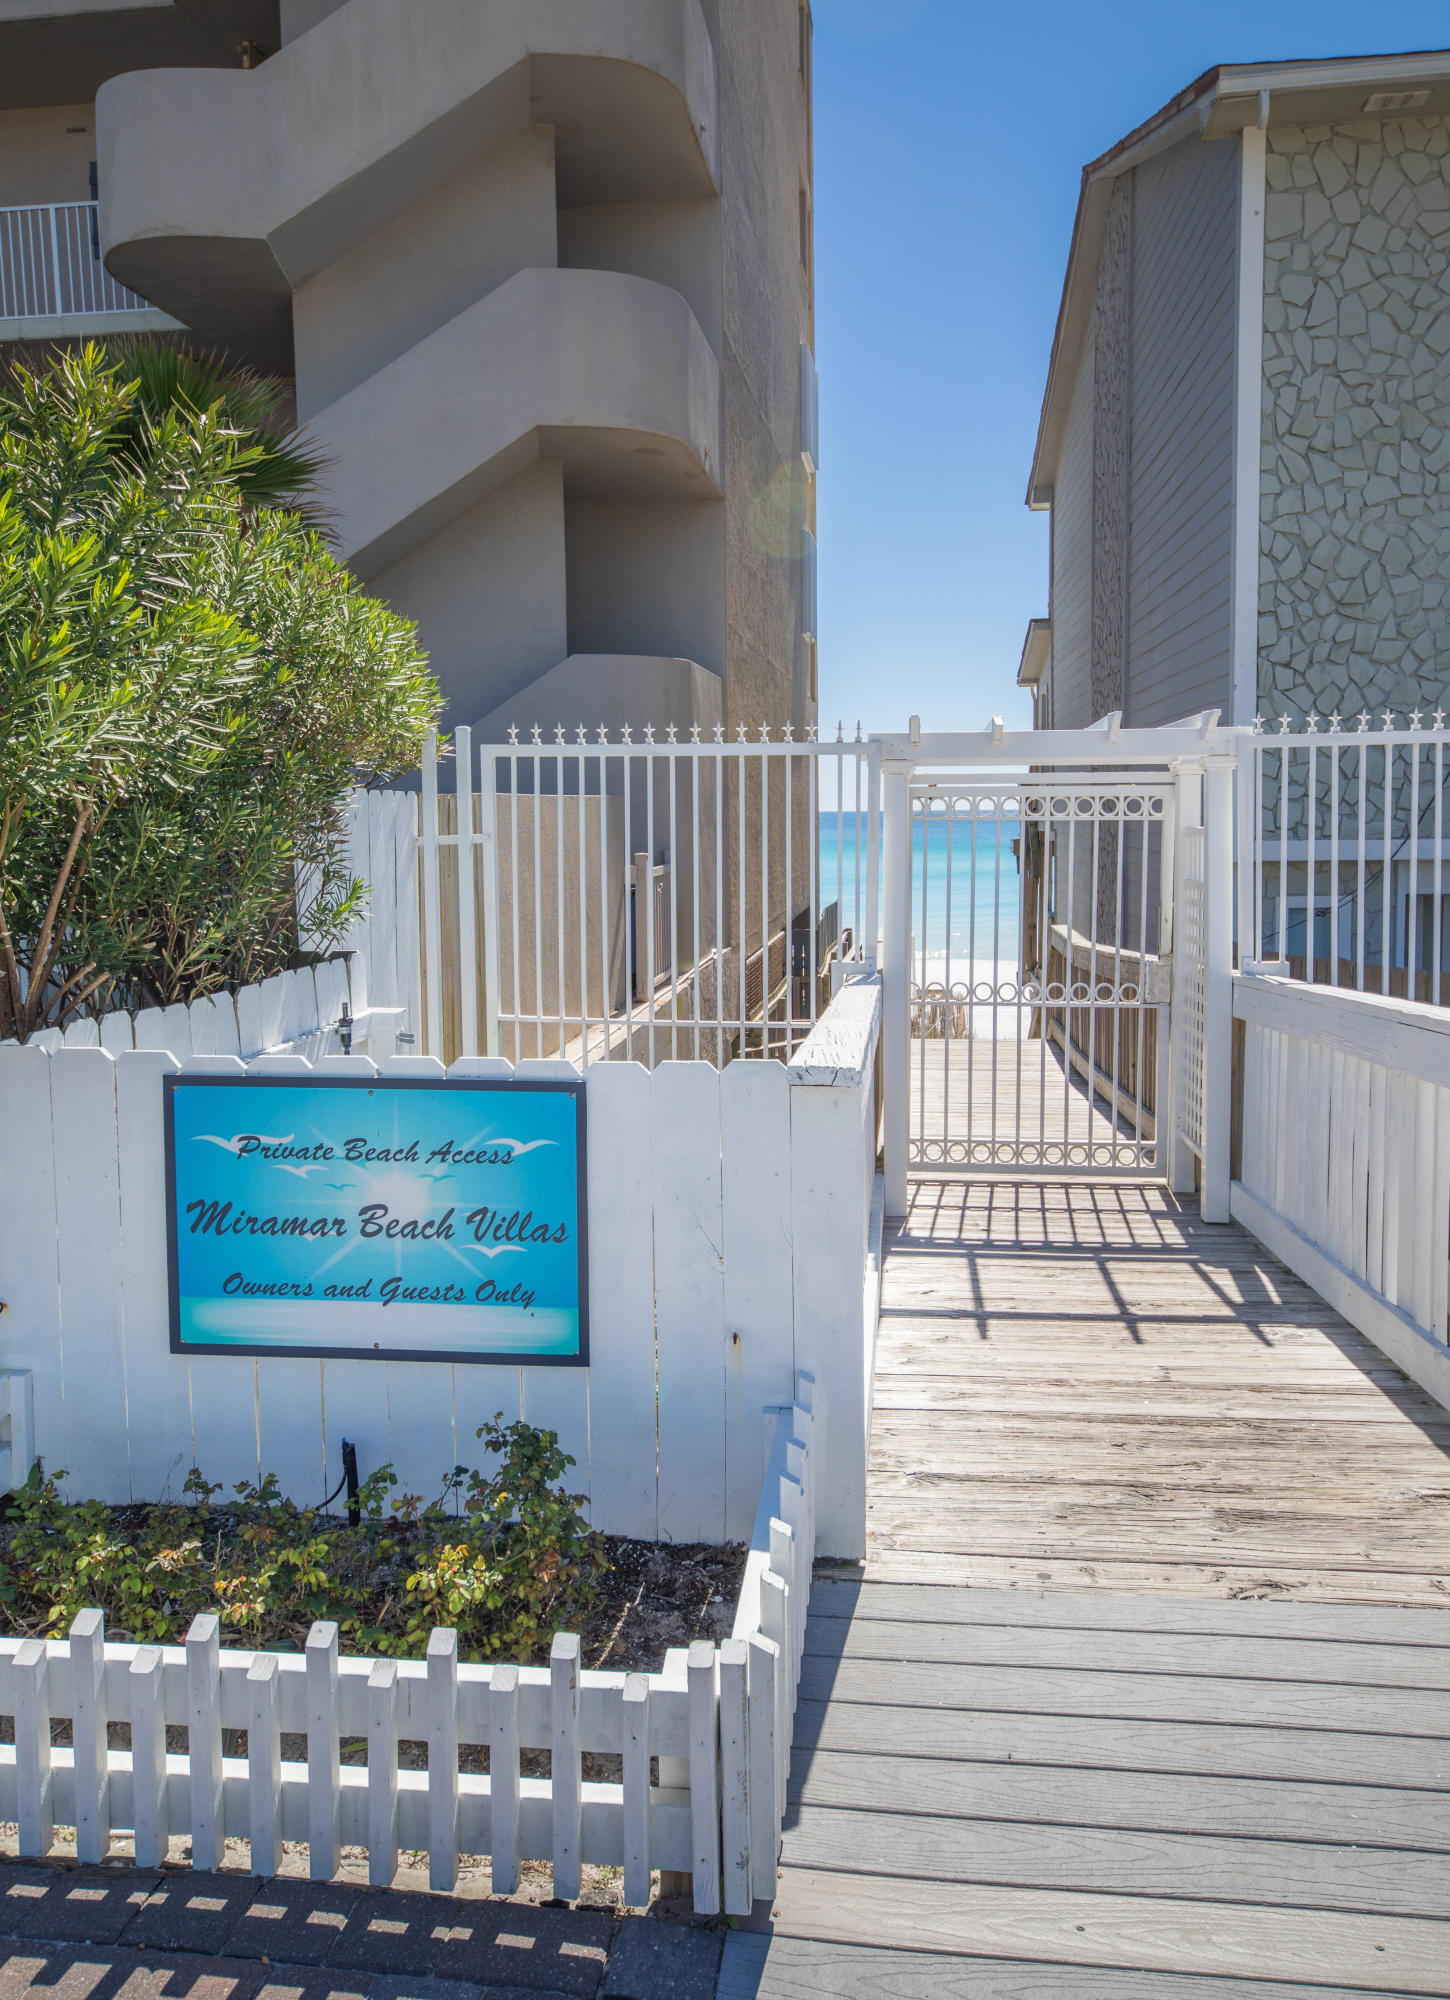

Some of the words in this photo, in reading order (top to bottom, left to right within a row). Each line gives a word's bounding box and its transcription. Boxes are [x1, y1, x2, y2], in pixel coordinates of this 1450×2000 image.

[237, 1135, 334, 1161] Private
[344, 1137, 419, 1163] Beach
[425, 1139, 514, 1165] Access
[186, 1199, 347, 1238] Miramar
[359, 1203, 456, 1241] Beach
[466, 1206, 569, 1244] Villas
[223, 1273, 315, 1297] Owners
[324, 1278, 373, 1299] and
[380, 1276, 466, 1307] Guests
[475, 1279, 535, 1310] Only
